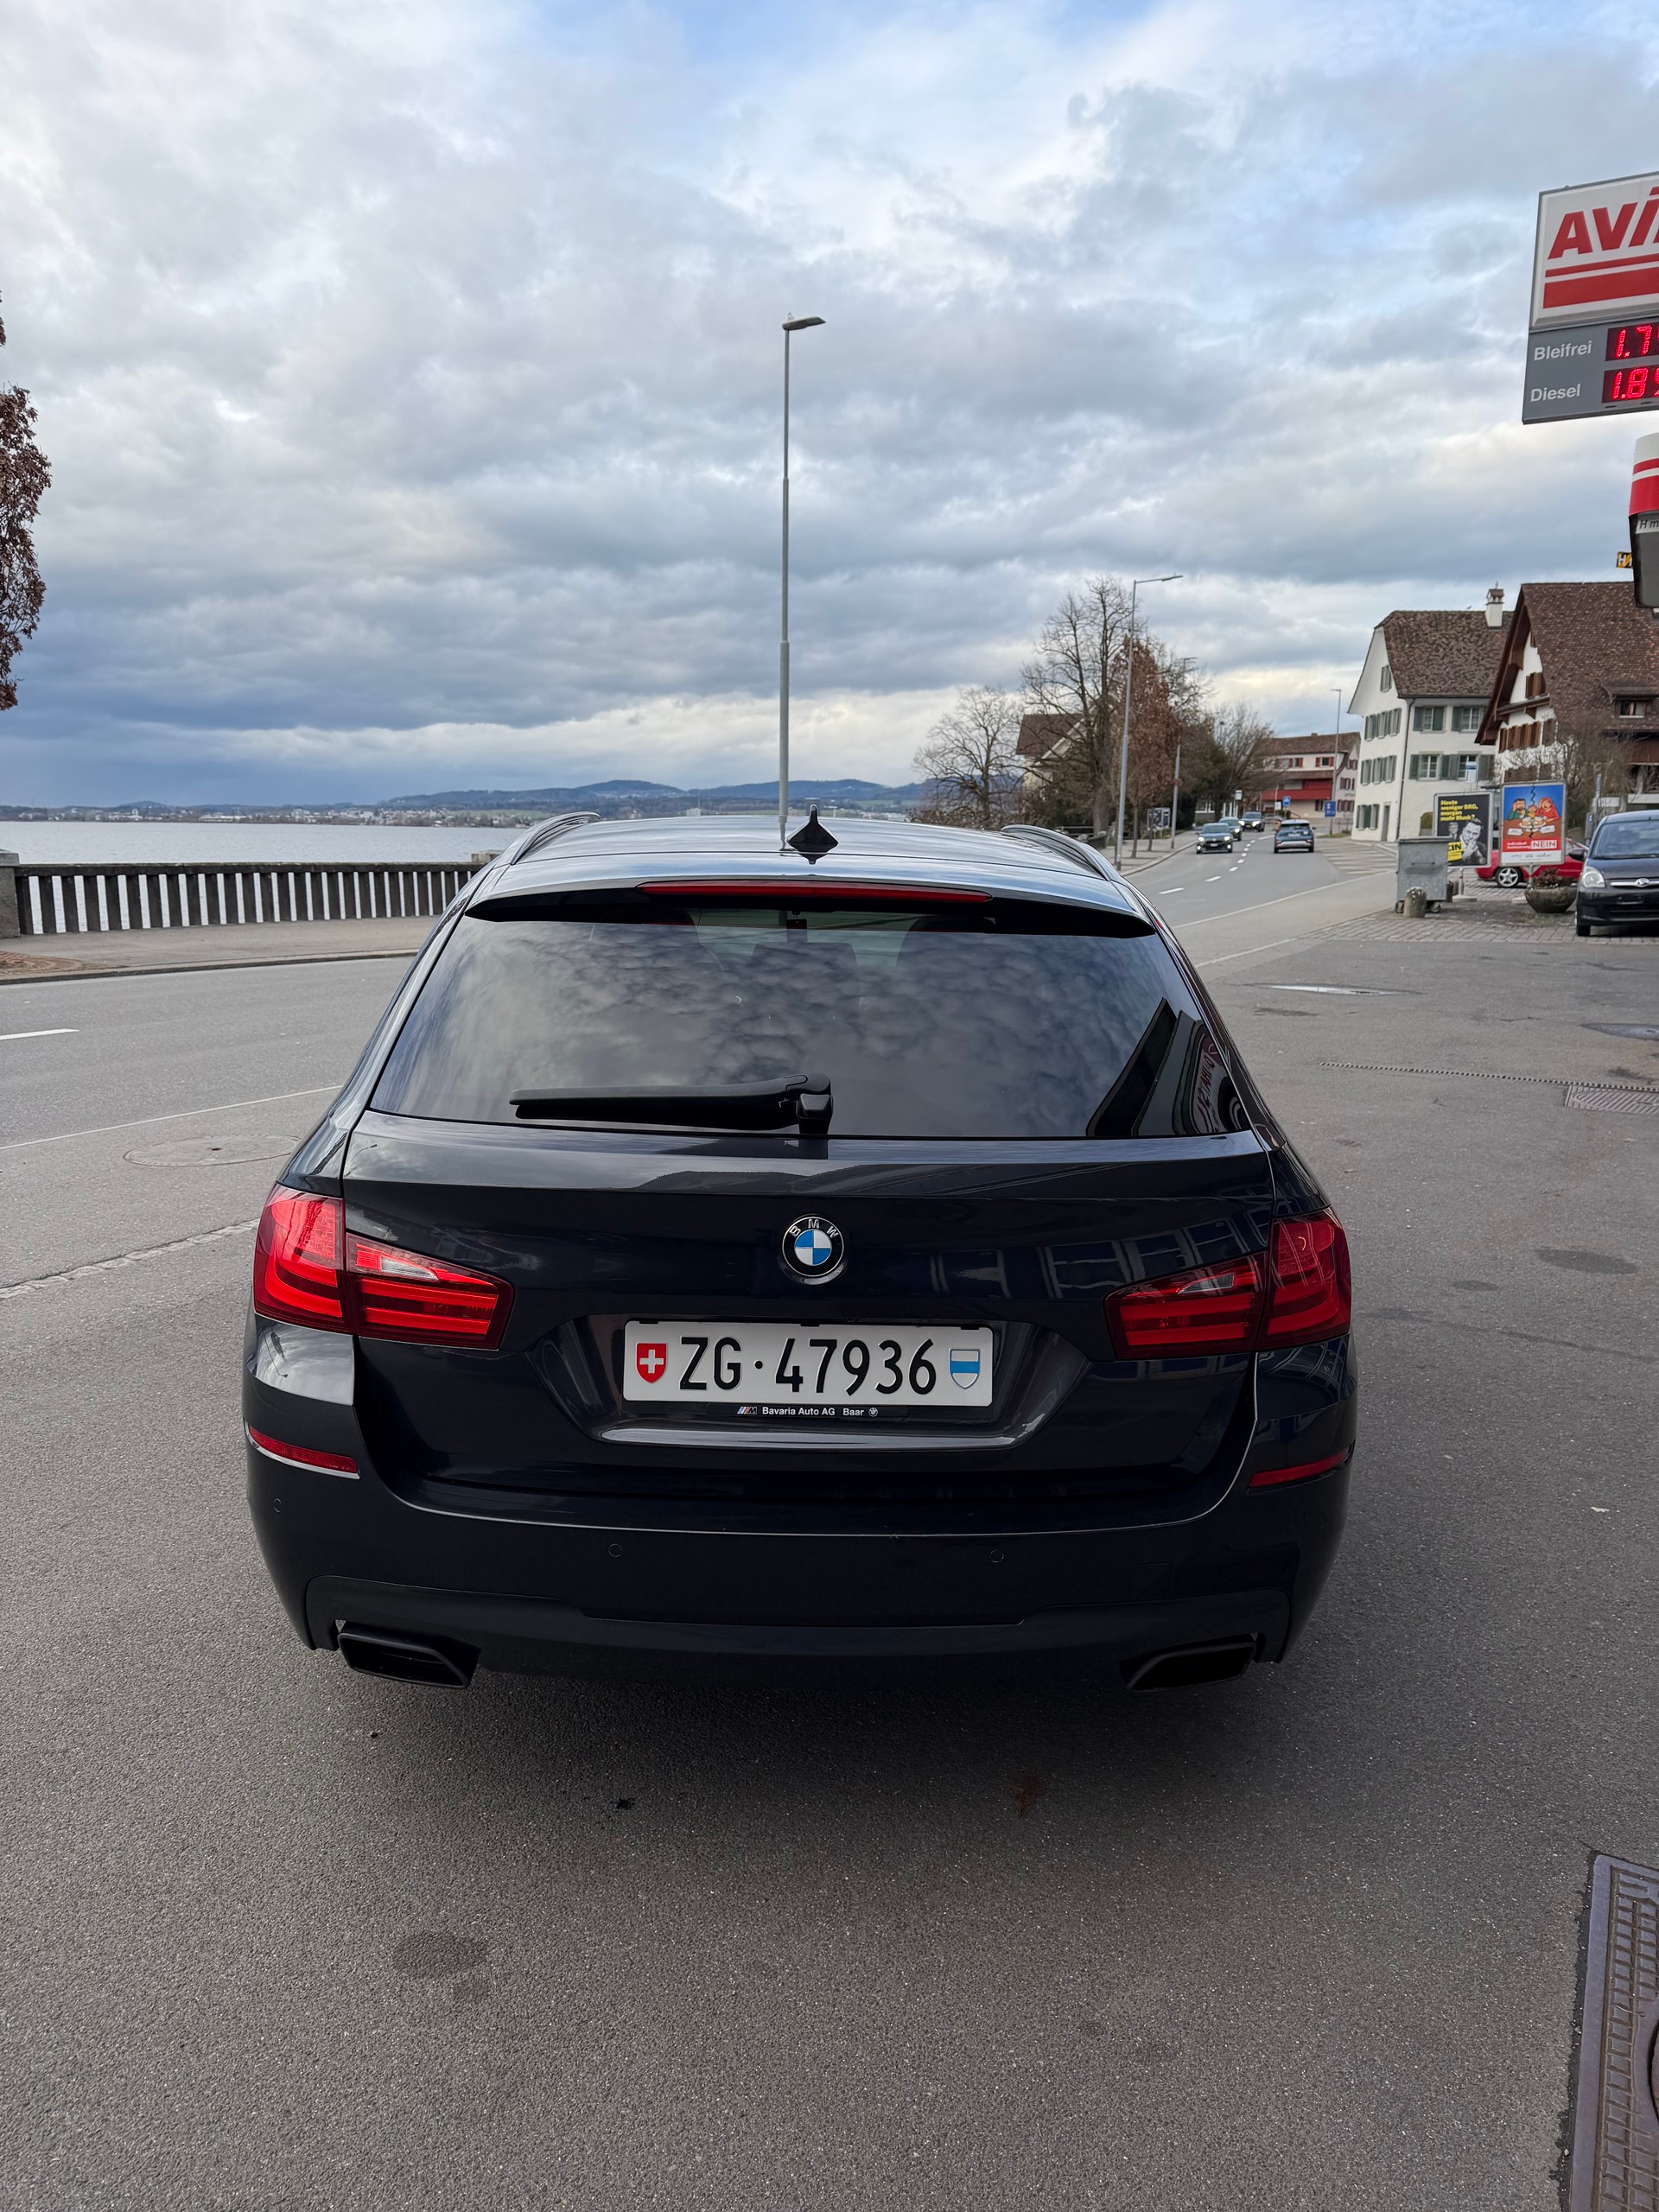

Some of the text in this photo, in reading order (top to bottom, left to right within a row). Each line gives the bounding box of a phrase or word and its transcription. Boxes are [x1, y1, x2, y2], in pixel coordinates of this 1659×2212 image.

[1534, 324, 1659, 361] Bleifrei 1.7
[1530, 384, 1580, 402] Diesel
[789, 1218, 839, 1239] BMW
[679, 1336, 742, 1391] ZG
[775, 1338, 937, 1396] 47936
[762, 1407, 796, 1415] Bavaria
[798, 1408, 819, 1416] Auto
[822, 1408, 836, 1416] AG
[842, 1408, 865, 1416] Baar
